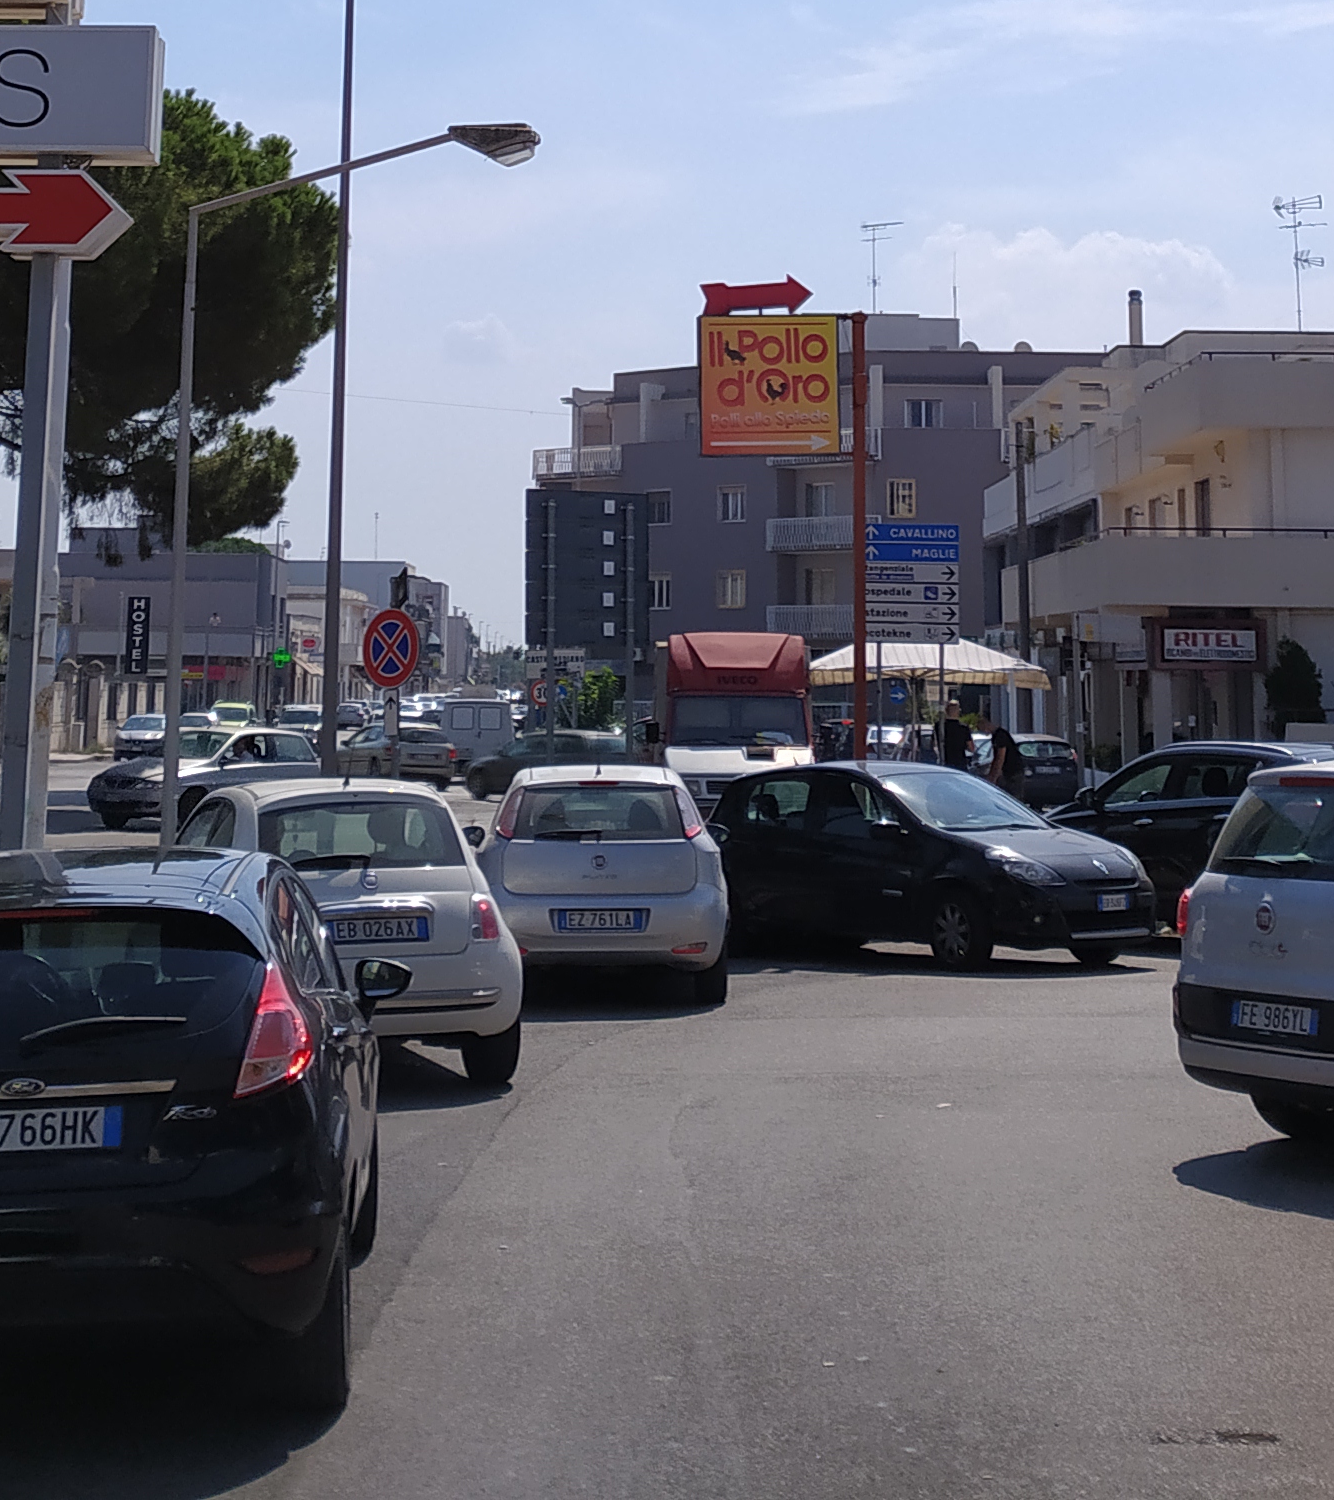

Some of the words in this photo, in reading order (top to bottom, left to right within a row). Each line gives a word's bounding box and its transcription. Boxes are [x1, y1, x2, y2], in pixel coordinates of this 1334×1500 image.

[708, 330, 724, 368] Il
[737, 327, 829, 366] Pollo
[717, 368, 831, 407] d'Oro
[710, 412, 741, 429] Polli
[775, 409, 831, 429] Spiedo
[889, 528, 957, 539] CAVALLINO
[911, 548, 957, 559] MAGLIE
[131, 598, 146, 673] HOSTEL
[1174, 631, 1245, 648] RITEL
[717, 675, 758, 685] IVECO
[335, 921, 358, 939] EB
[362, 919, 417, 938] 026AX
[568, 912, 586, 927] EZ
[590, 912, 633, 927] 761LA
[1240, 1002, 1260, 1027] FE
[1263, 1005, 1309, 1033] 986YL
